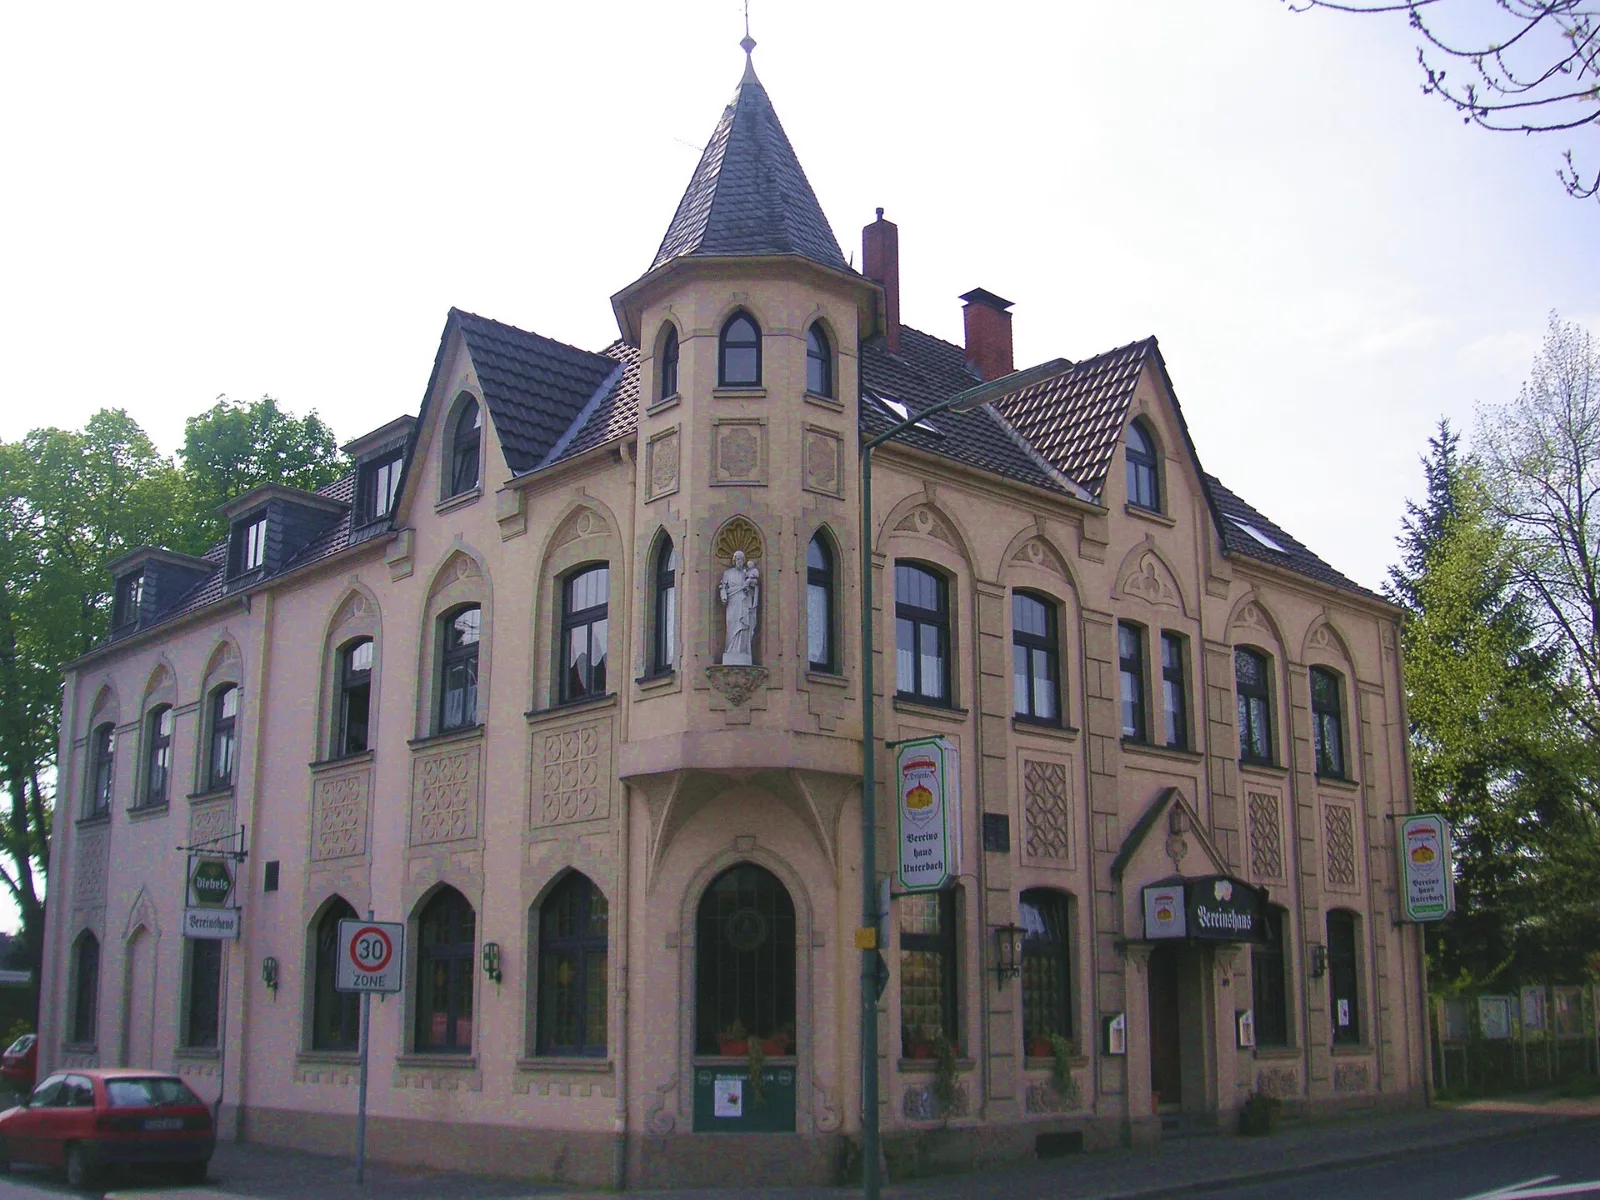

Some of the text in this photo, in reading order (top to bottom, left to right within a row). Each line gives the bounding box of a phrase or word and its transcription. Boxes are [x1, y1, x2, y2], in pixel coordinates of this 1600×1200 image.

[906, 832, 938, 843] Vereins
[913, 848, 933, 859] haus
[903, 860, 943, 873] Unterbach
[189, 915, 234, 932] Vereinshaus
[1197, 905, 1252, 934] Vereinshaus
[359, 938, 384, 961] 30
[353, 974, 386, 988] ZONE
